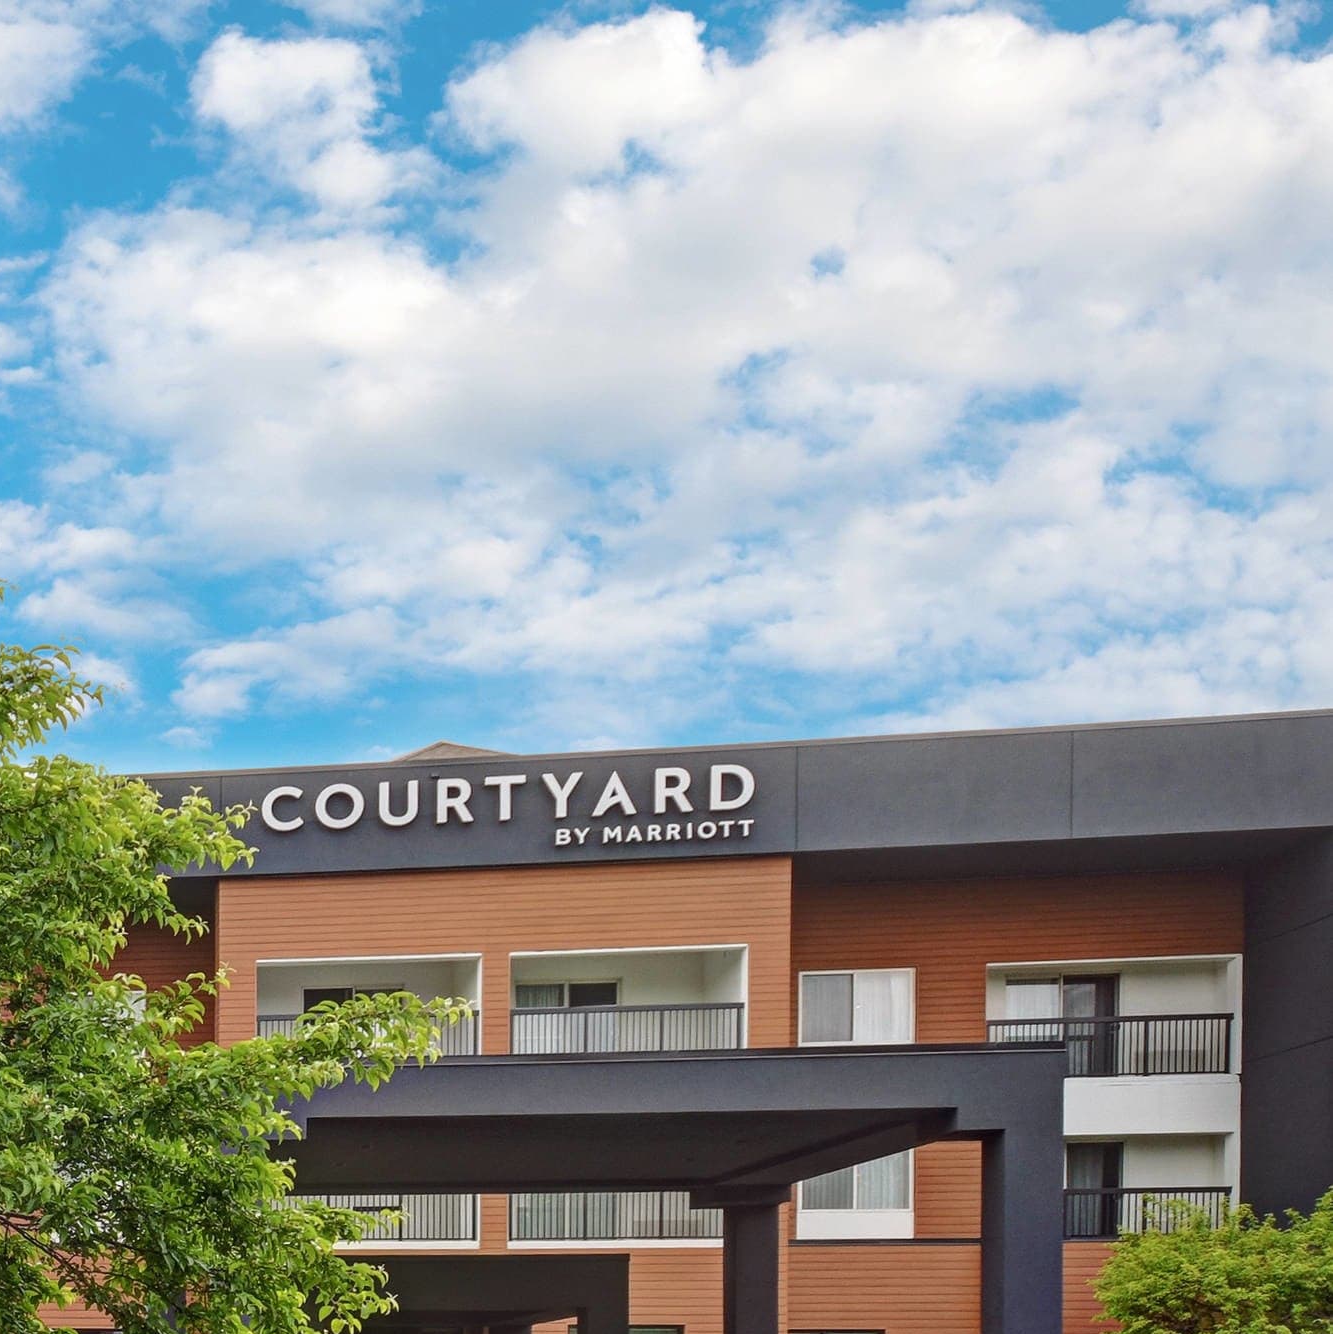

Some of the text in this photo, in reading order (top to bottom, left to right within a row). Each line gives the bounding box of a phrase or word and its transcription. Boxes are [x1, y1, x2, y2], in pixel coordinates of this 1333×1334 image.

[261, 763, 756, 832] COURTYARD
[555, 819, 755, 846] BY MARRIOTT
